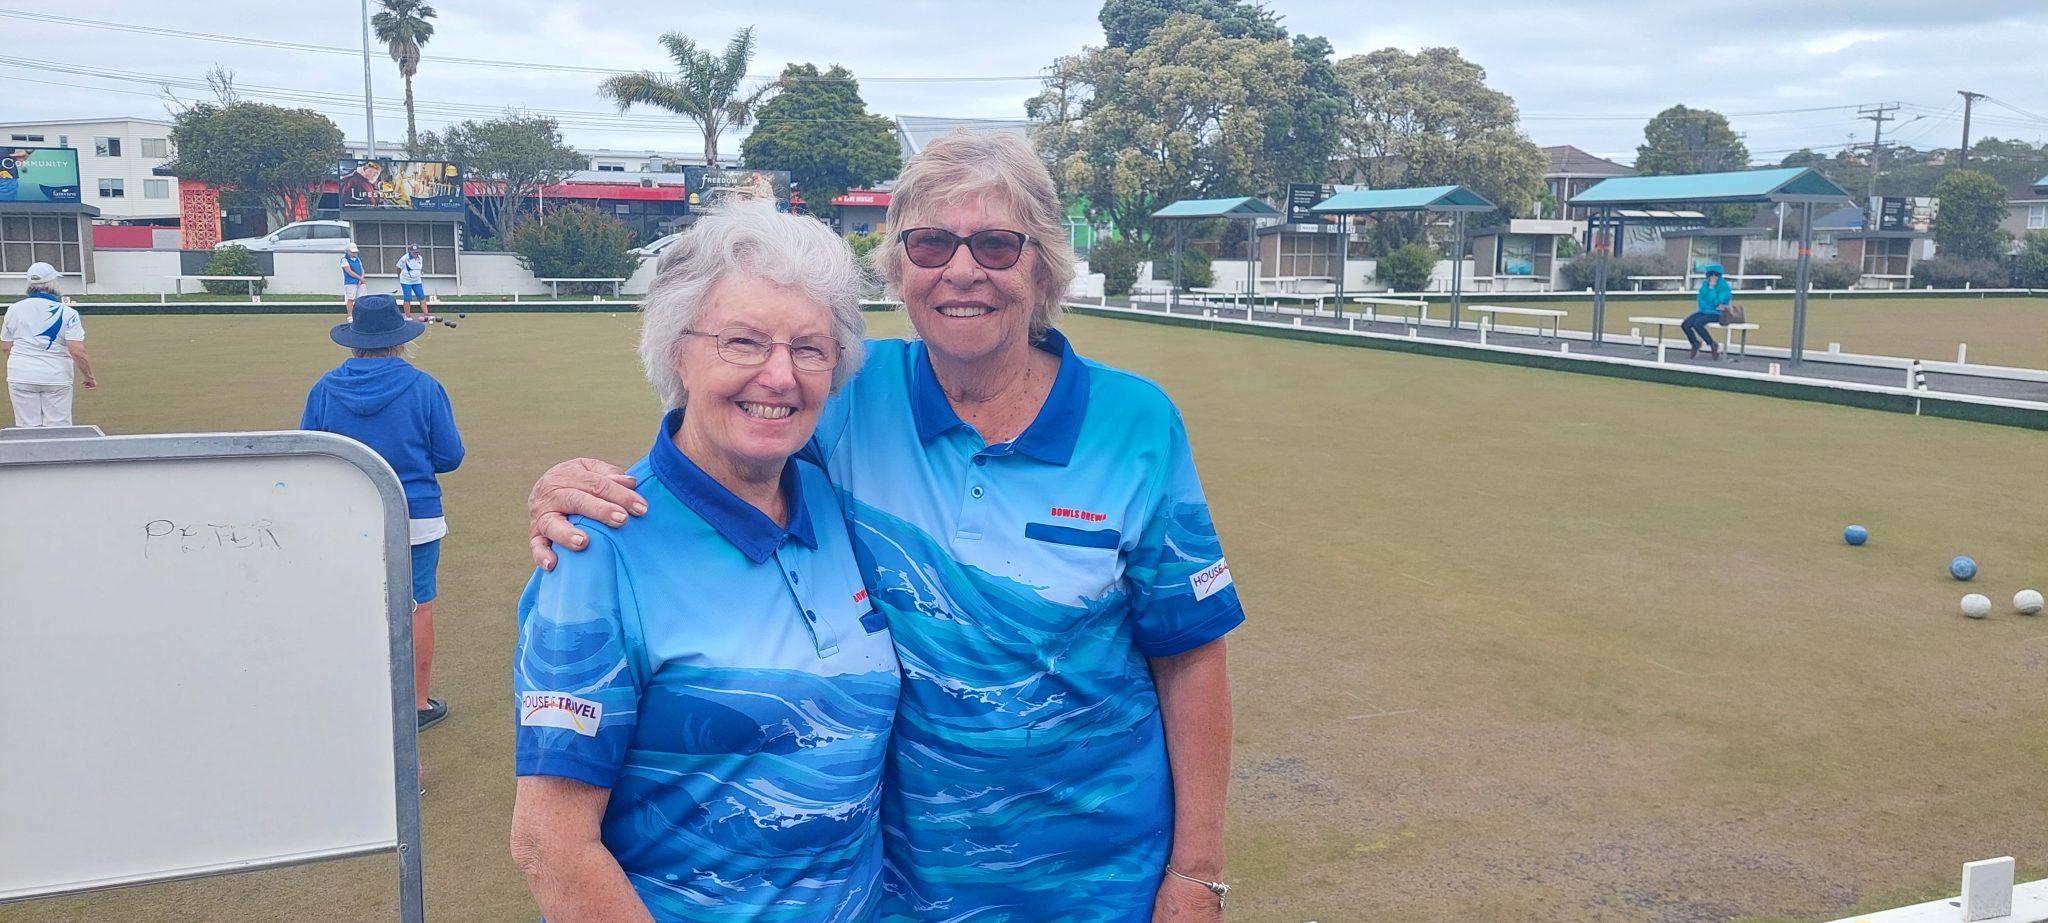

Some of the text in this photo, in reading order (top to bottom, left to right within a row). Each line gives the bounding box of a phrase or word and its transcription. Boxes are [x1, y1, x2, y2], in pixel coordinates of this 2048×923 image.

[1, 157, 68, 169] COMMUNITY
[351, 187, 401, 201] LIFESTYLE
[1051, 507, 1080, 519] BOWLS
[144, 519, 282, 559] PETER
[1193, 563, 1224, 587] HOUSE
[853, 590, 868, 603] BOW
